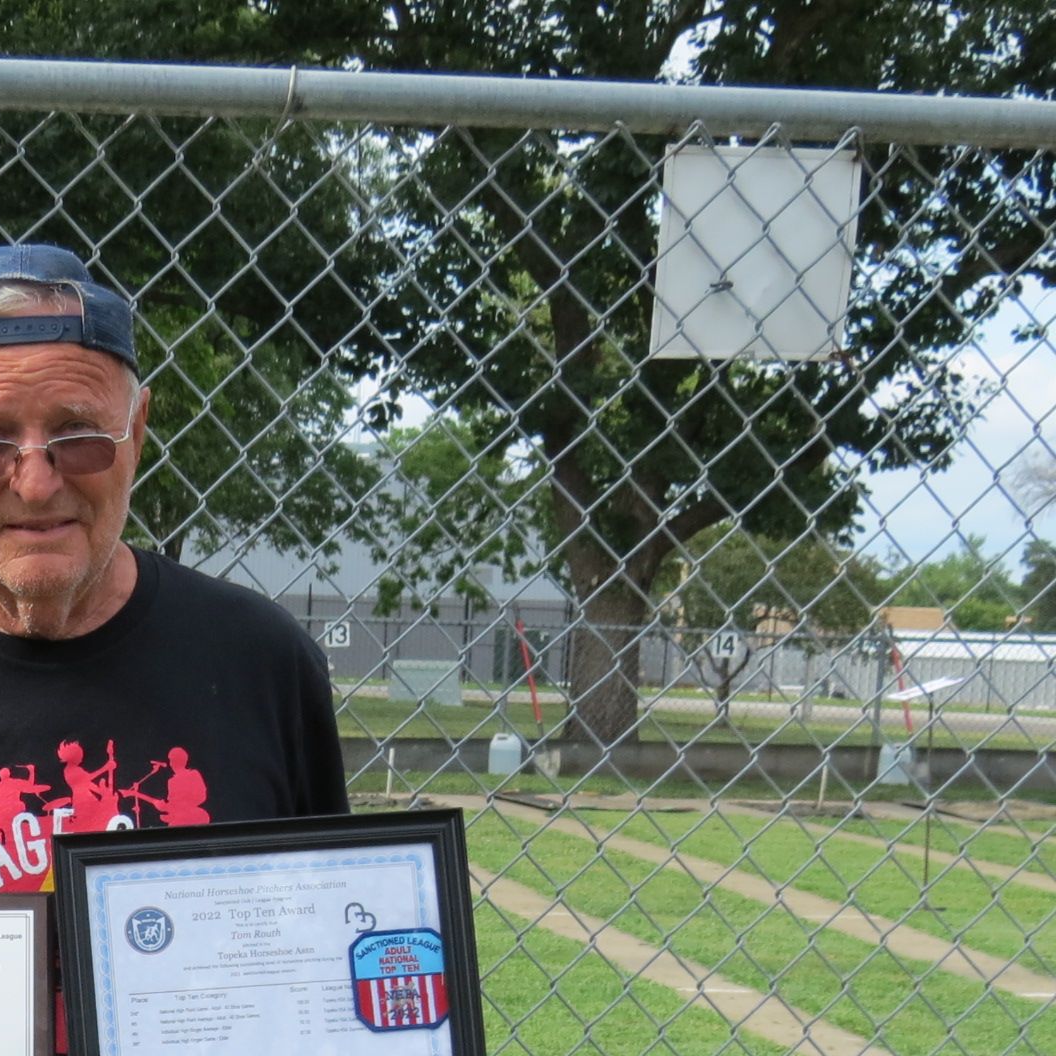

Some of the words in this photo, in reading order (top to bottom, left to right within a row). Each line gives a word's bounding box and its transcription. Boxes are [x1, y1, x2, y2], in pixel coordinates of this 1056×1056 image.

[327, 624, 347, 645] 13
[716, 635, 734, 655] 14
[164, 889, 204, 900] National
[206, 886, 254, 897] Horseshoe
[256, 884, 293, 894] Pitchers
[296, 881, 346, 891] Association
[192, 912, 221, 921] 2022
[228, 909, 251, 922] Top
[253, 907, 276, 917] Ten
[278, 904, 316, 917] Award
[231, 932, 252, 940] Tom
[254, 928, 282, 939] Routh
[217, 950, 248, 961] Topeka
[250, 948, 292, 958] Horseshoe
[356, 936, 404, 960] SANCTIONED
[407, 937, 441, 954] LEAGUE
[384, 946, 412, 954] ADULT
[379, 954, 419, 964] NATIONAL
[380, 966, 396, 974] TOP
[402, 965, 420, 973] TEN
